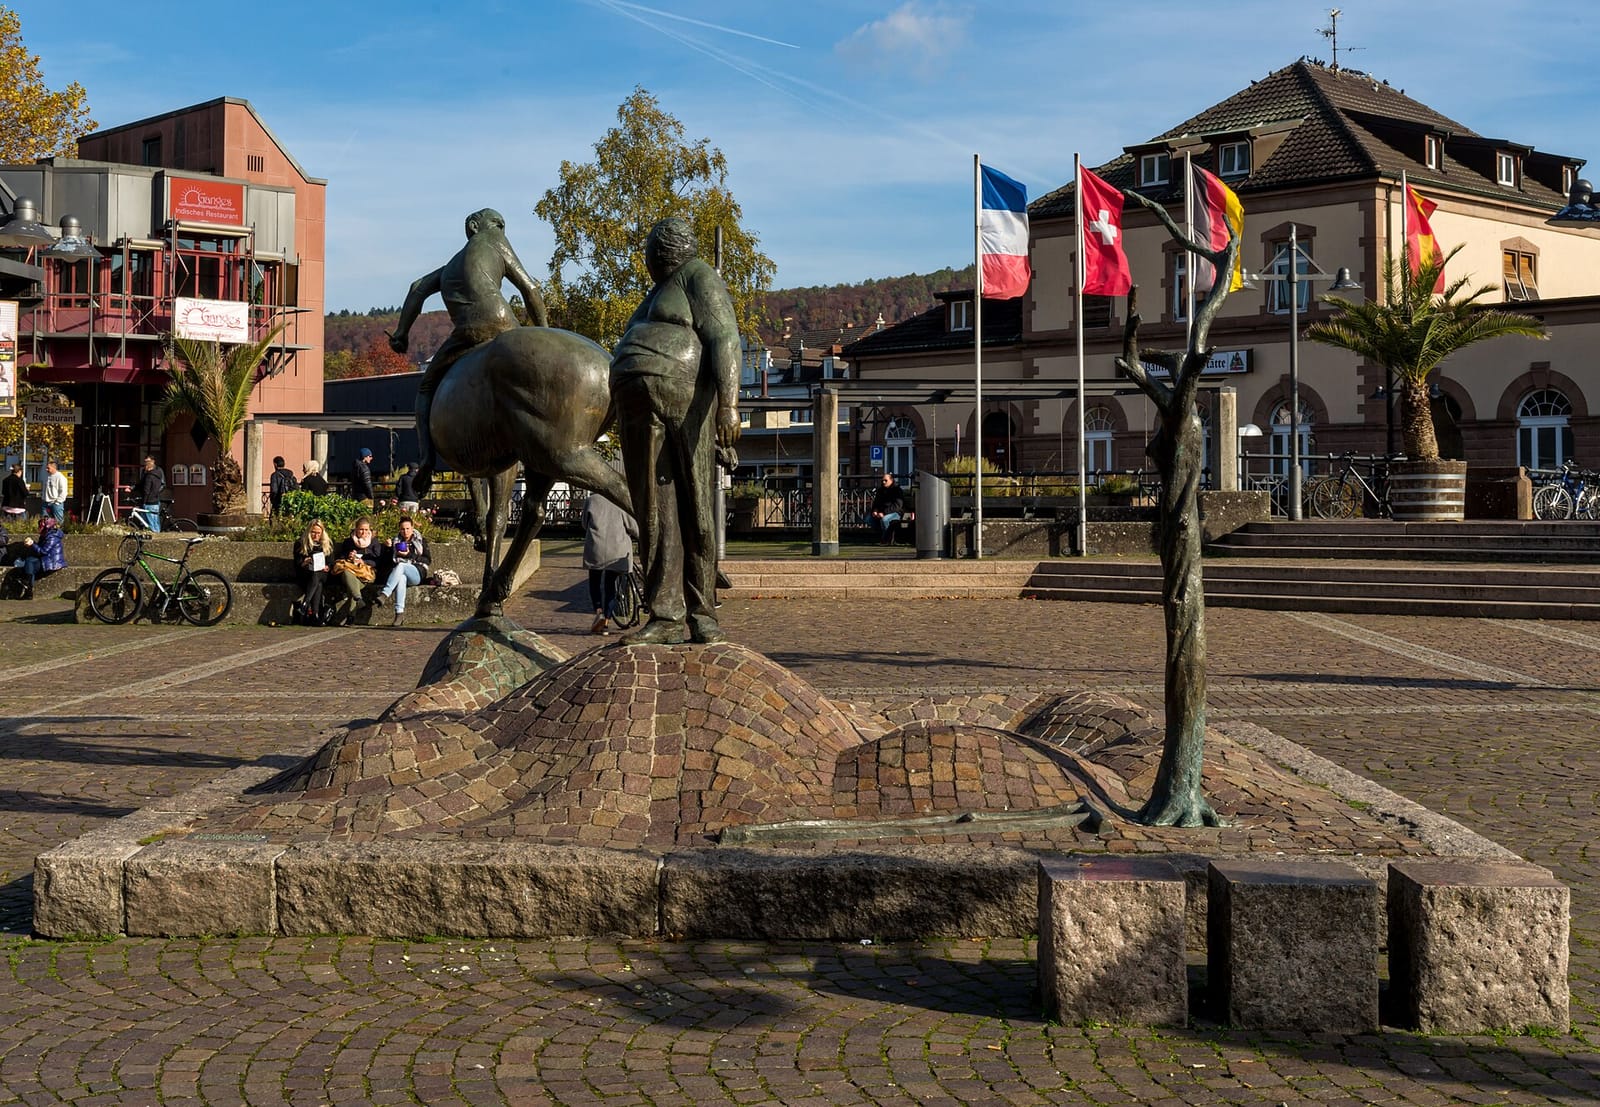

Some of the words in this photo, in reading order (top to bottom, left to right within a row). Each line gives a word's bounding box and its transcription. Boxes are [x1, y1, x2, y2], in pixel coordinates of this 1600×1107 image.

[175, 208, 204, 216] Indisches
[205, 211, 239, 220] Restaurant
[35, 406, 74, 415] Indisches
[32, 414, 76, 422] Restaurant
[873, 447, 881, 459] P
